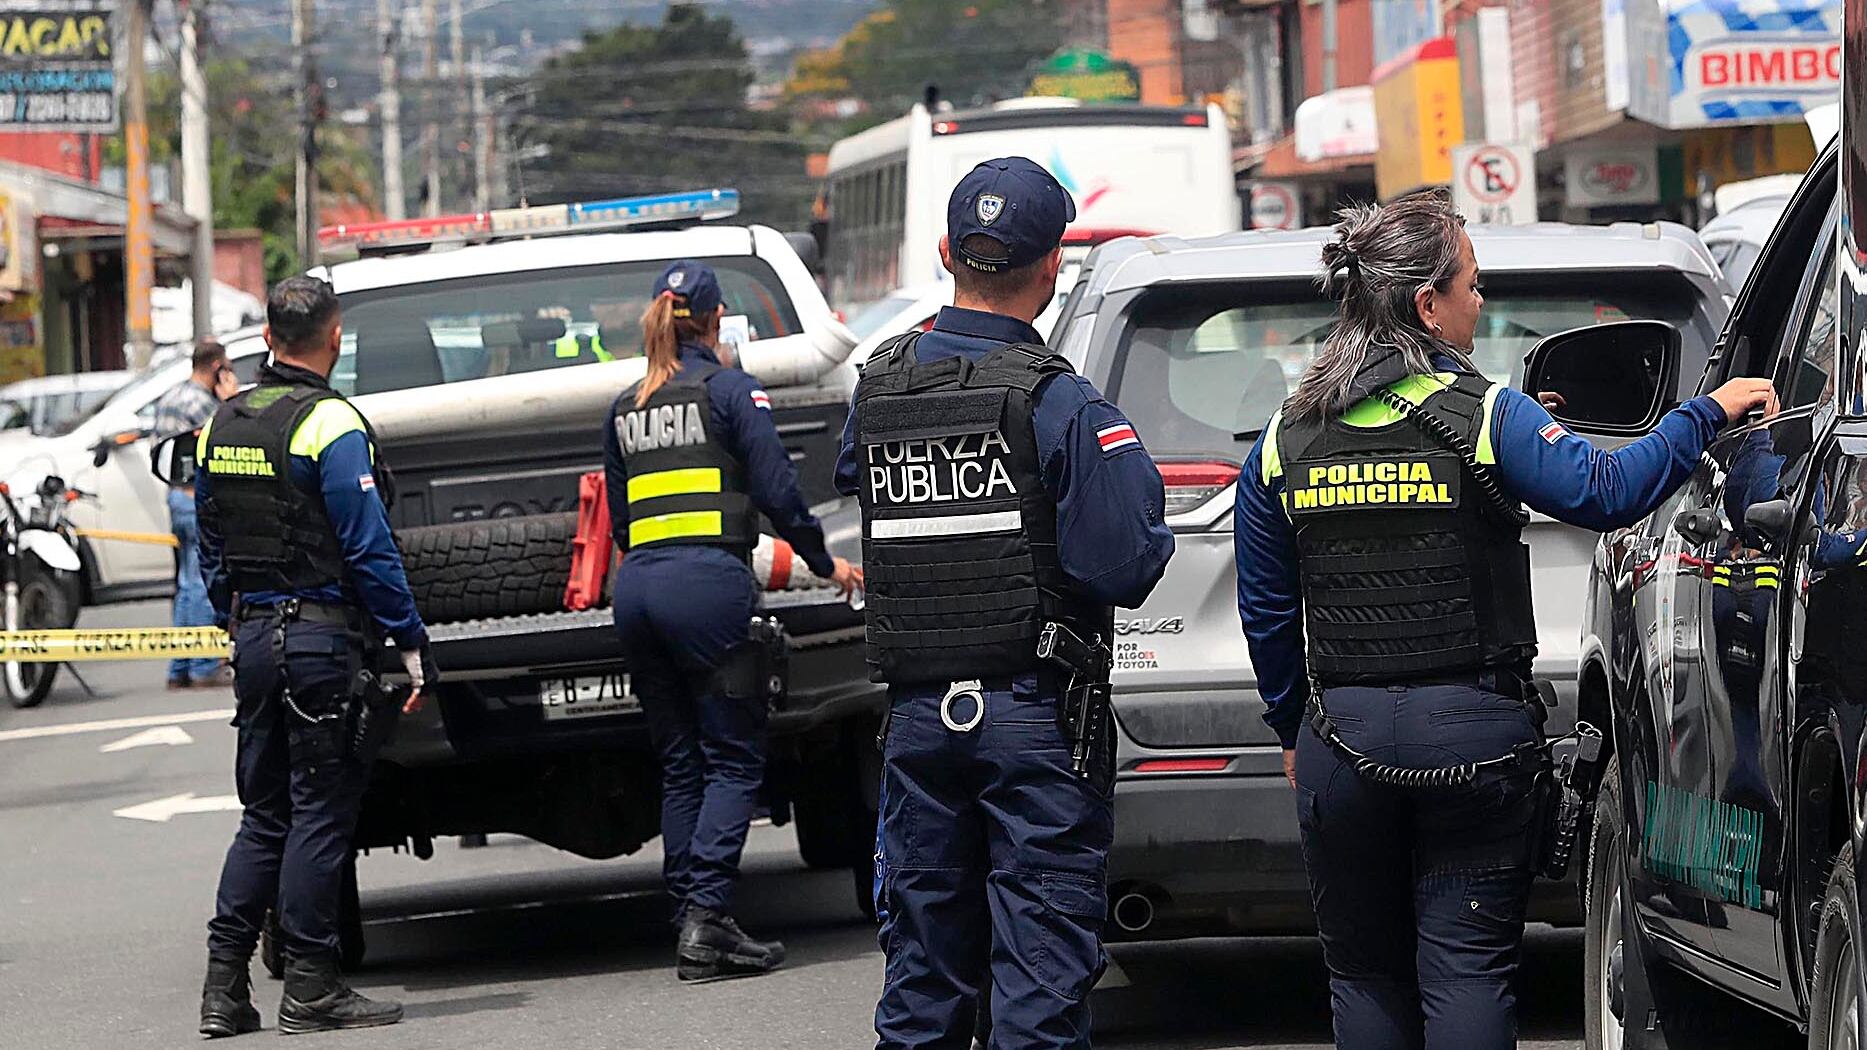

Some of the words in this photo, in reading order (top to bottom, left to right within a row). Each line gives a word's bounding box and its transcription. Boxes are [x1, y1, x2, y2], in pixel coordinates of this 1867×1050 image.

[966, 257, 998, 273] POLICIA
[614, 402, 707, 458] POLICIA
[213, 446, 266, 461] POLICIA
[867, 431, 1011, 464] FUERZA
[208, 459, 275, 477] MUNICIPAL
[1309, 462, 1432, 486] POLICIA
[869, 458, 1017, 504] PUBLICA
[1294, 483, 1452, 509] MUNICIPAL
[12, 634, 49, 653] PASE
[73, 633, 134, 653] FUERZA
[138, 631, 202, 650] PUBLICA
[1117, 643, 1138, 652] POR
[1117, 660, 1159, 669] TOYOTA
